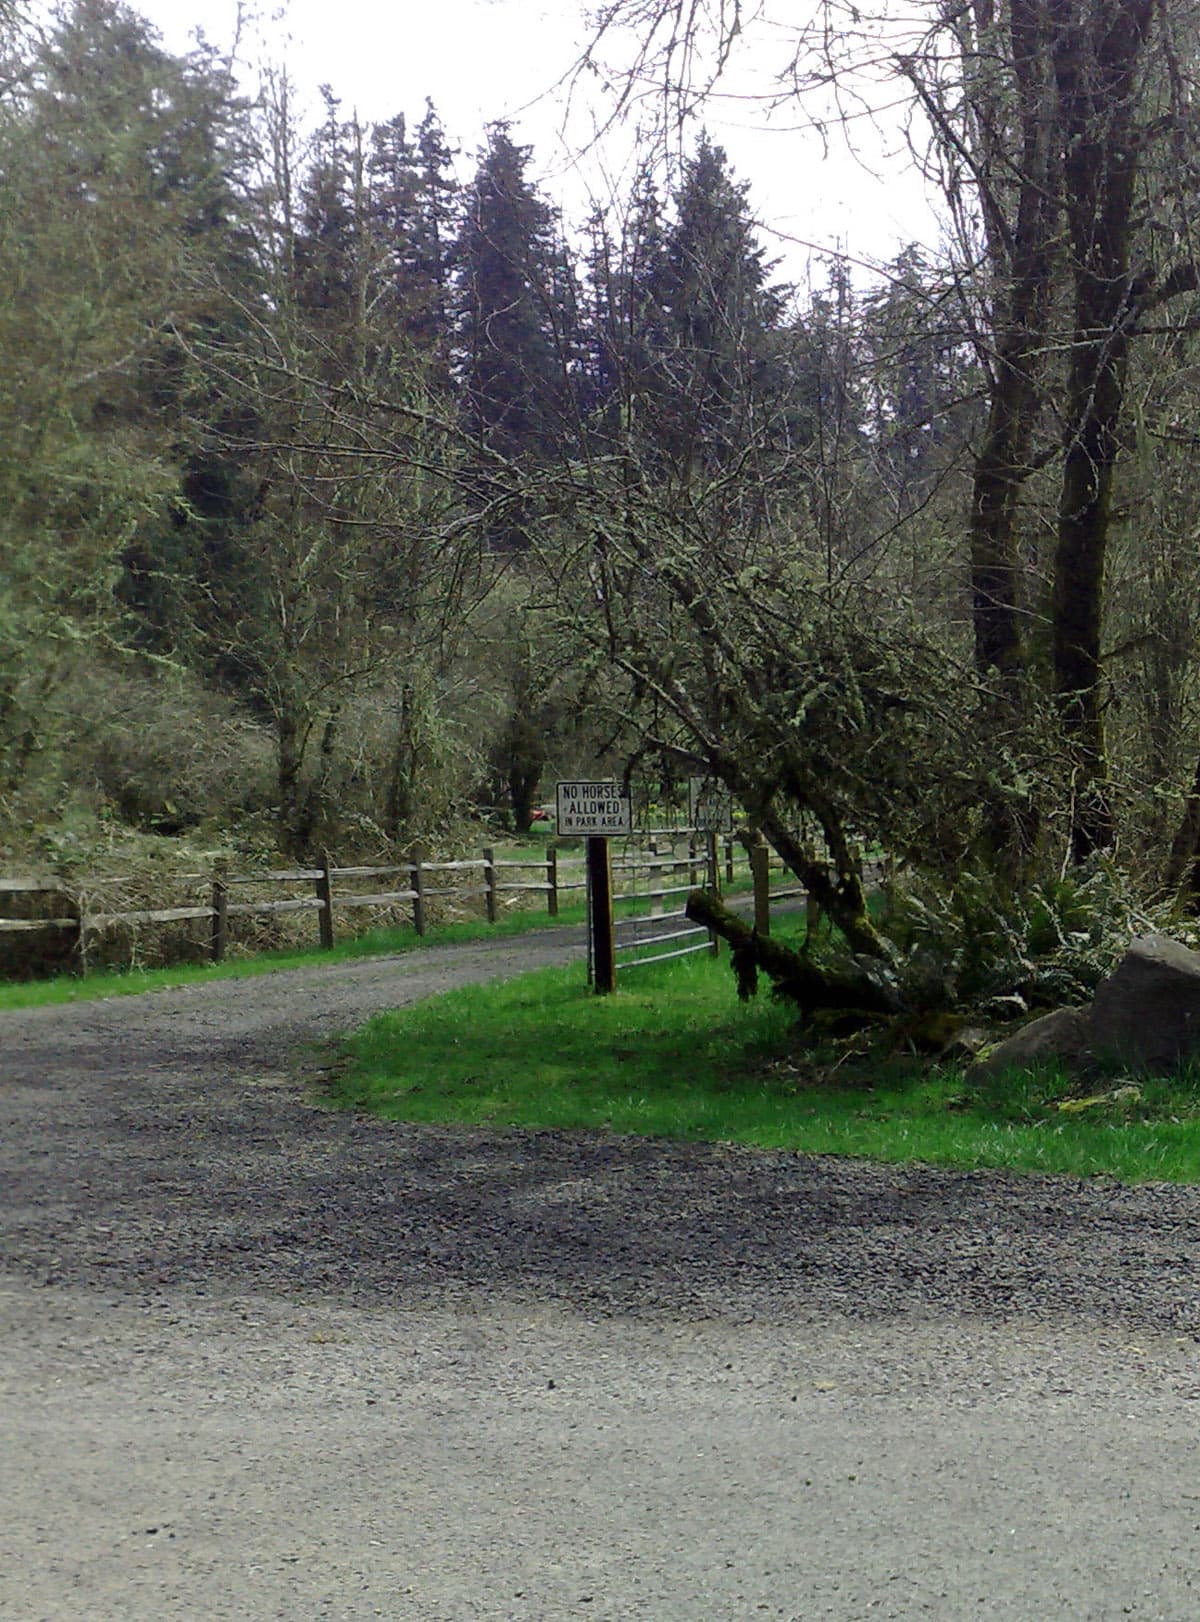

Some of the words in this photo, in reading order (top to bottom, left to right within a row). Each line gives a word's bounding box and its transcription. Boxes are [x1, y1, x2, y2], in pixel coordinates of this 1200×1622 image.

[563, 786, 578, 799] NO
[569, 801, 620, 814] ALLOWED
[565, 817, 573, 826] IN
[576, 817, 597, 826] PARK
[601, 817, 624, 826] AREA
